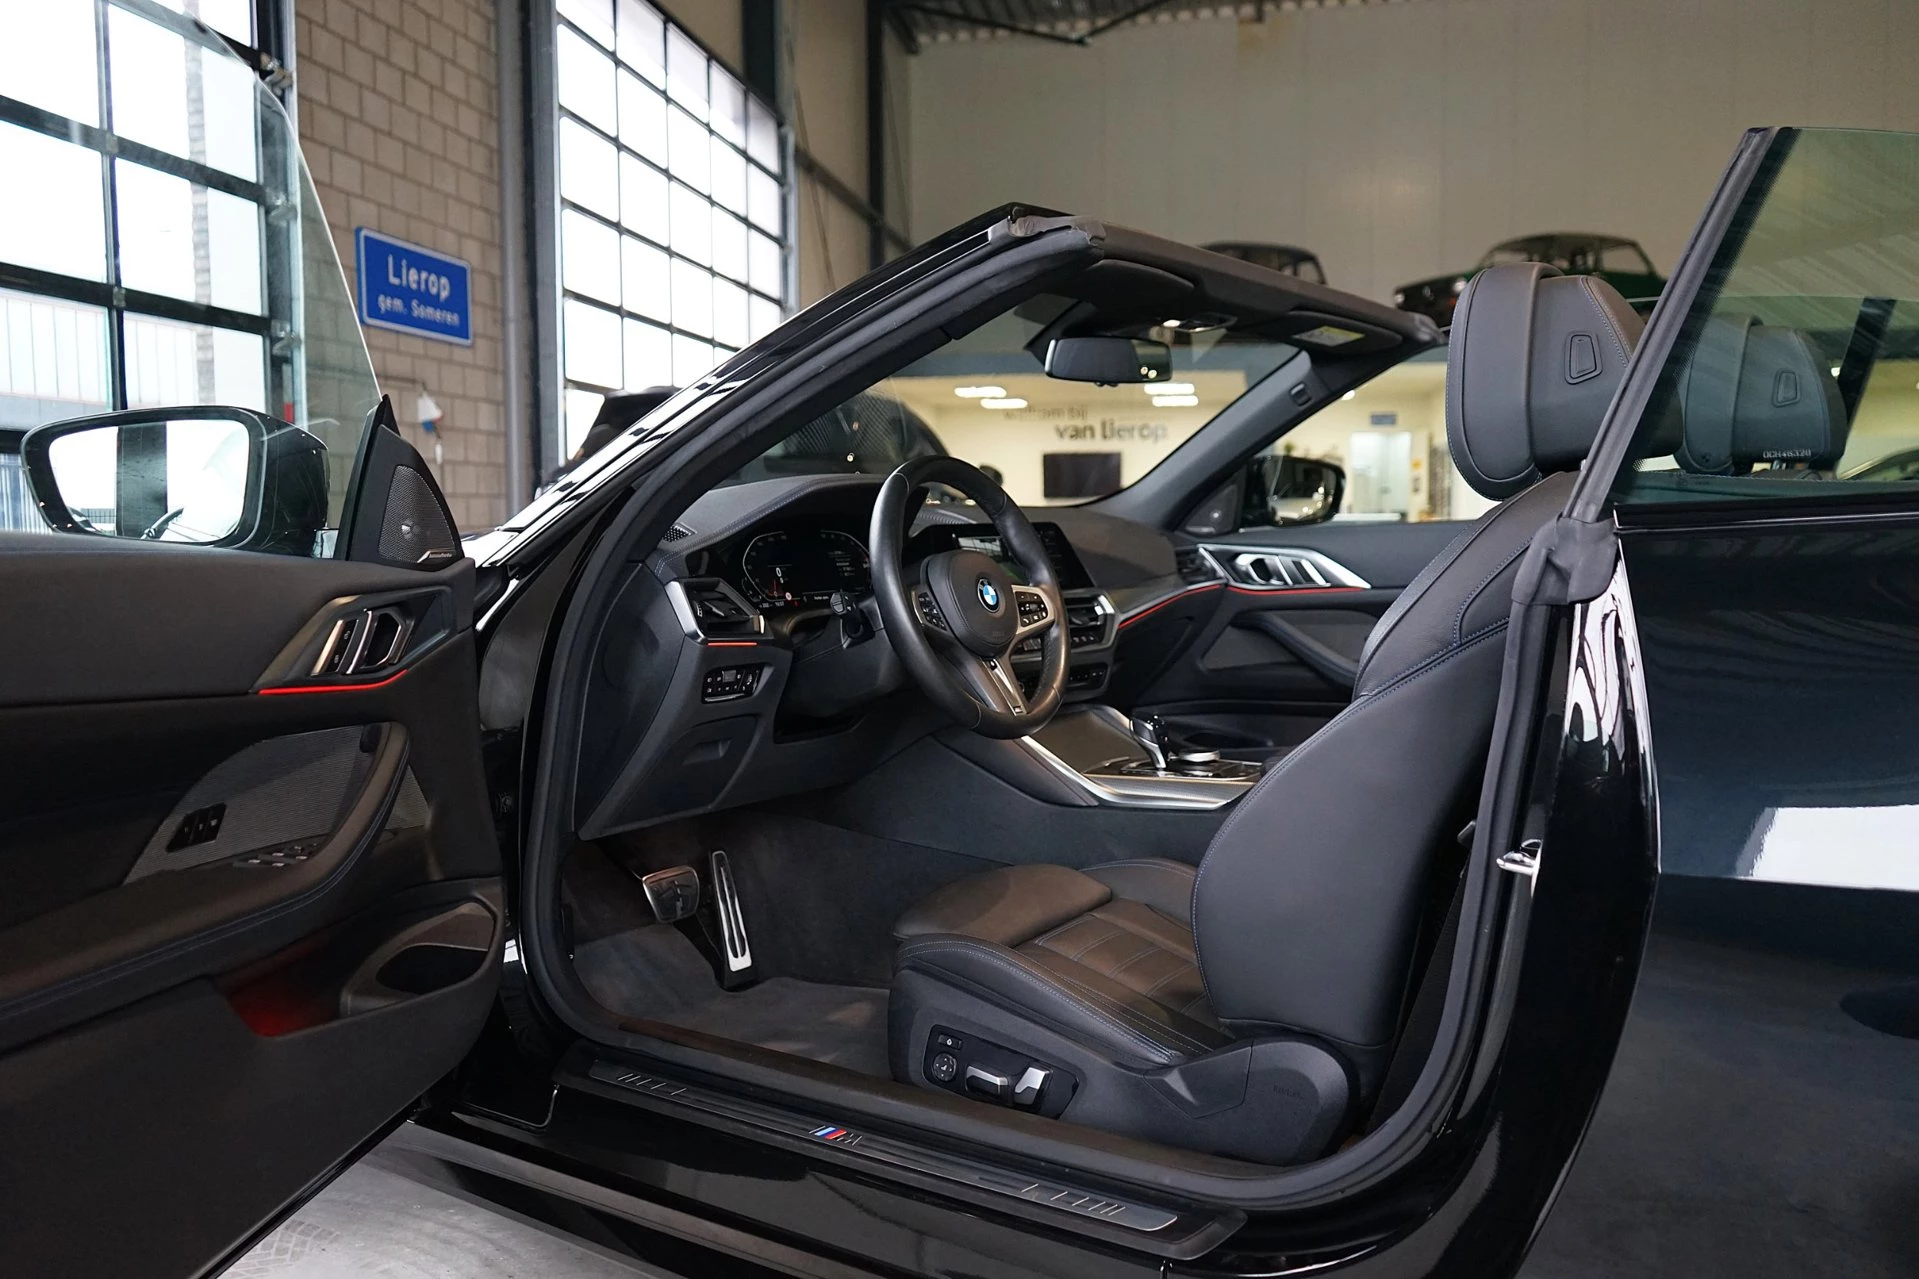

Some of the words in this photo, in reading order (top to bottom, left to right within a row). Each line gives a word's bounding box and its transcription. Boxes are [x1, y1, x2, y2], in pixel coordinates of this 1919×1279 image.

[387, 253, 451, 302] Lierop
[377, 293, 408, 315] gem.
[1054, 423, 1096, 441] van
